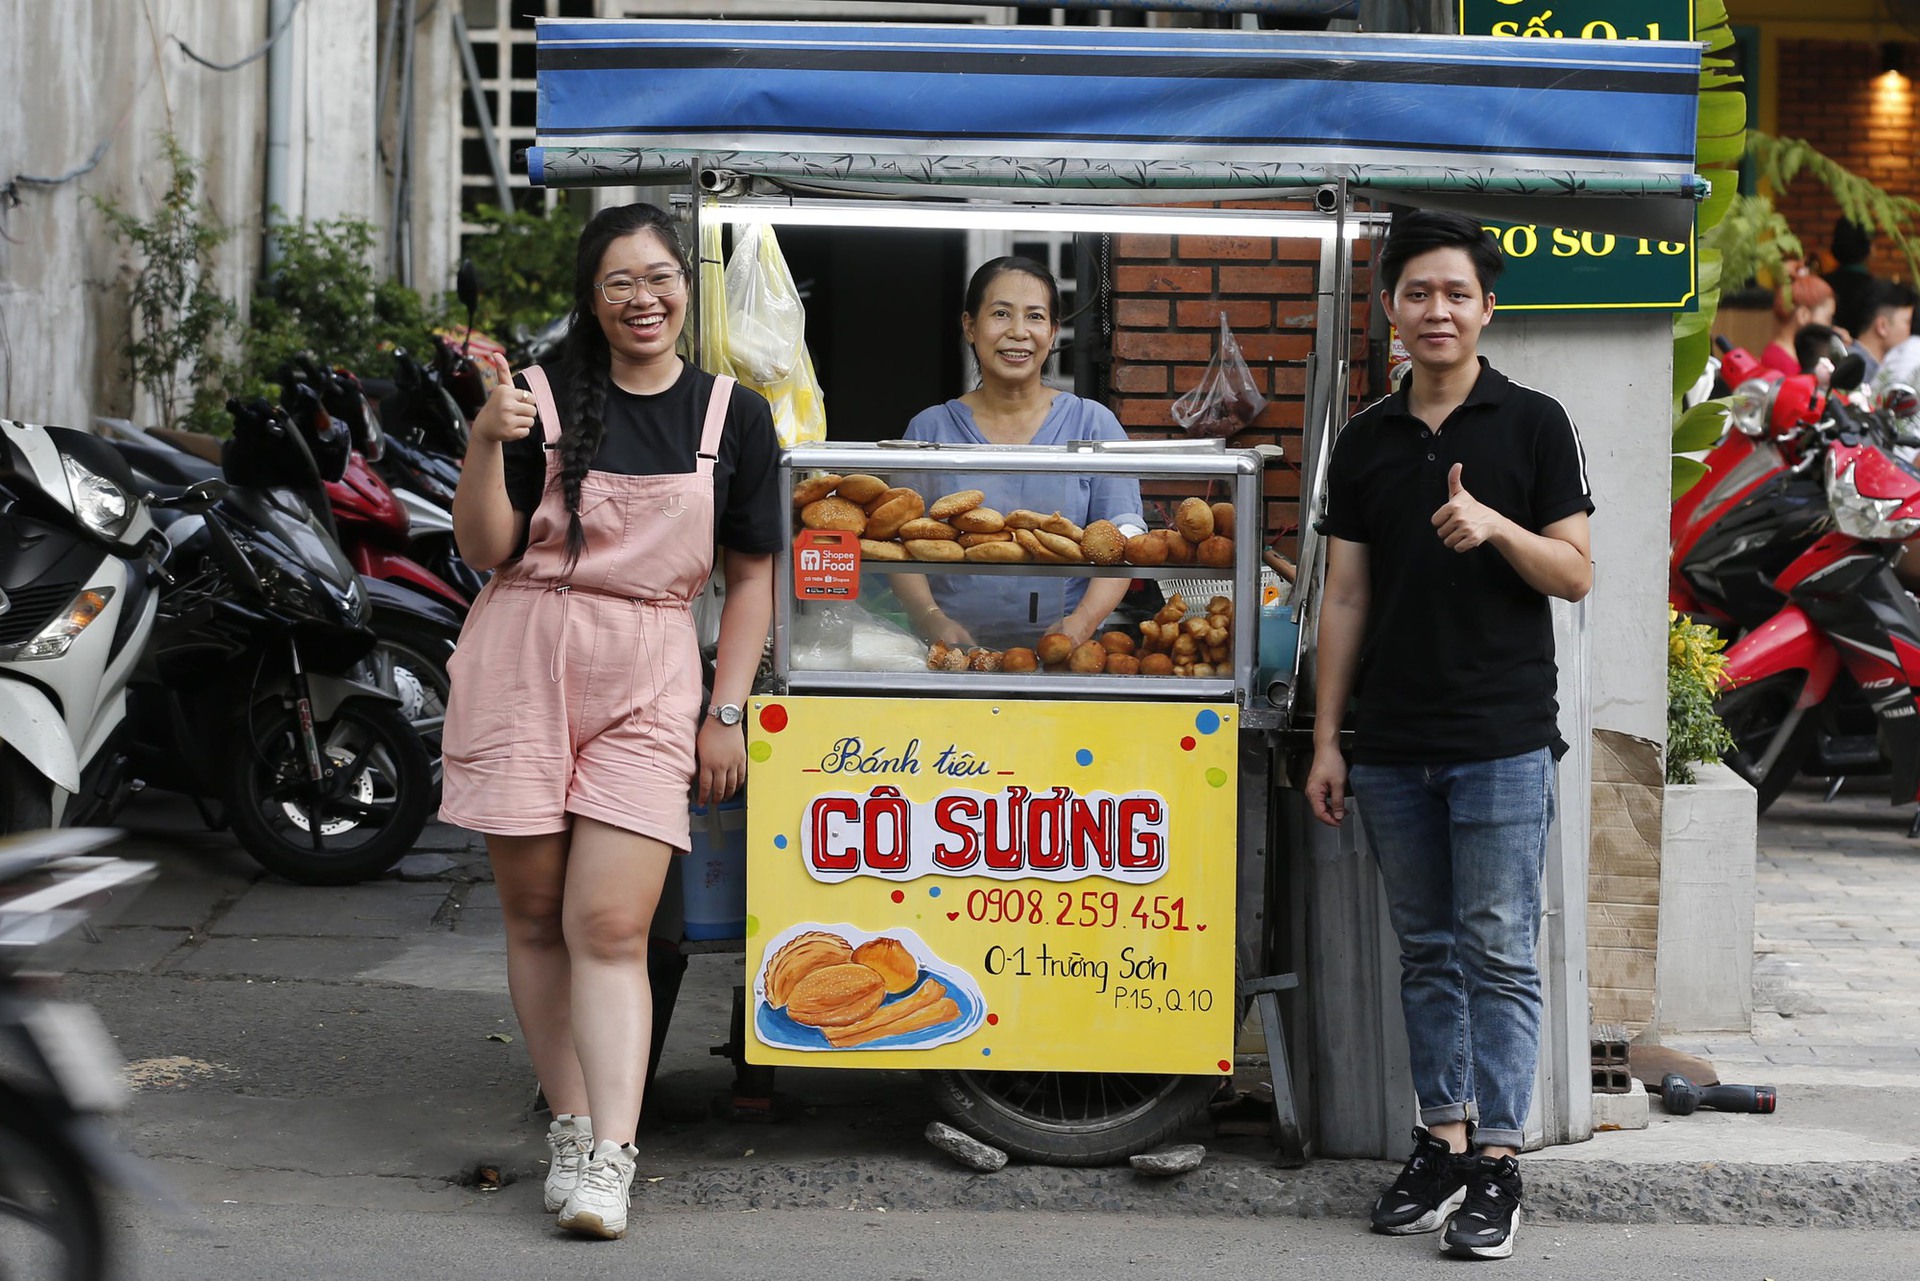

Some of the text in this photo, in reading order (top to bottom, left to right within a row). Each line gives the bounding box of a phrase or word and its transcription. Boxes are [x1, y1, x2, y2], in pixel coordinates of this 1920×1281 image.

[822, 549, 855, 561] Shopee
[822, 559, 855, 572] Food
[1882, 705, 1916, 719] YAMAHA
[821, 736, 991, 777] Bánh tiêu
[811, 785, 1164, 873] CÔ SƯƠNG
[966, 888, 1190, 931] 0908.259.451
[1036, 943, 1109, 994] trường
[1119, 946, 1168, 981] Sơn
